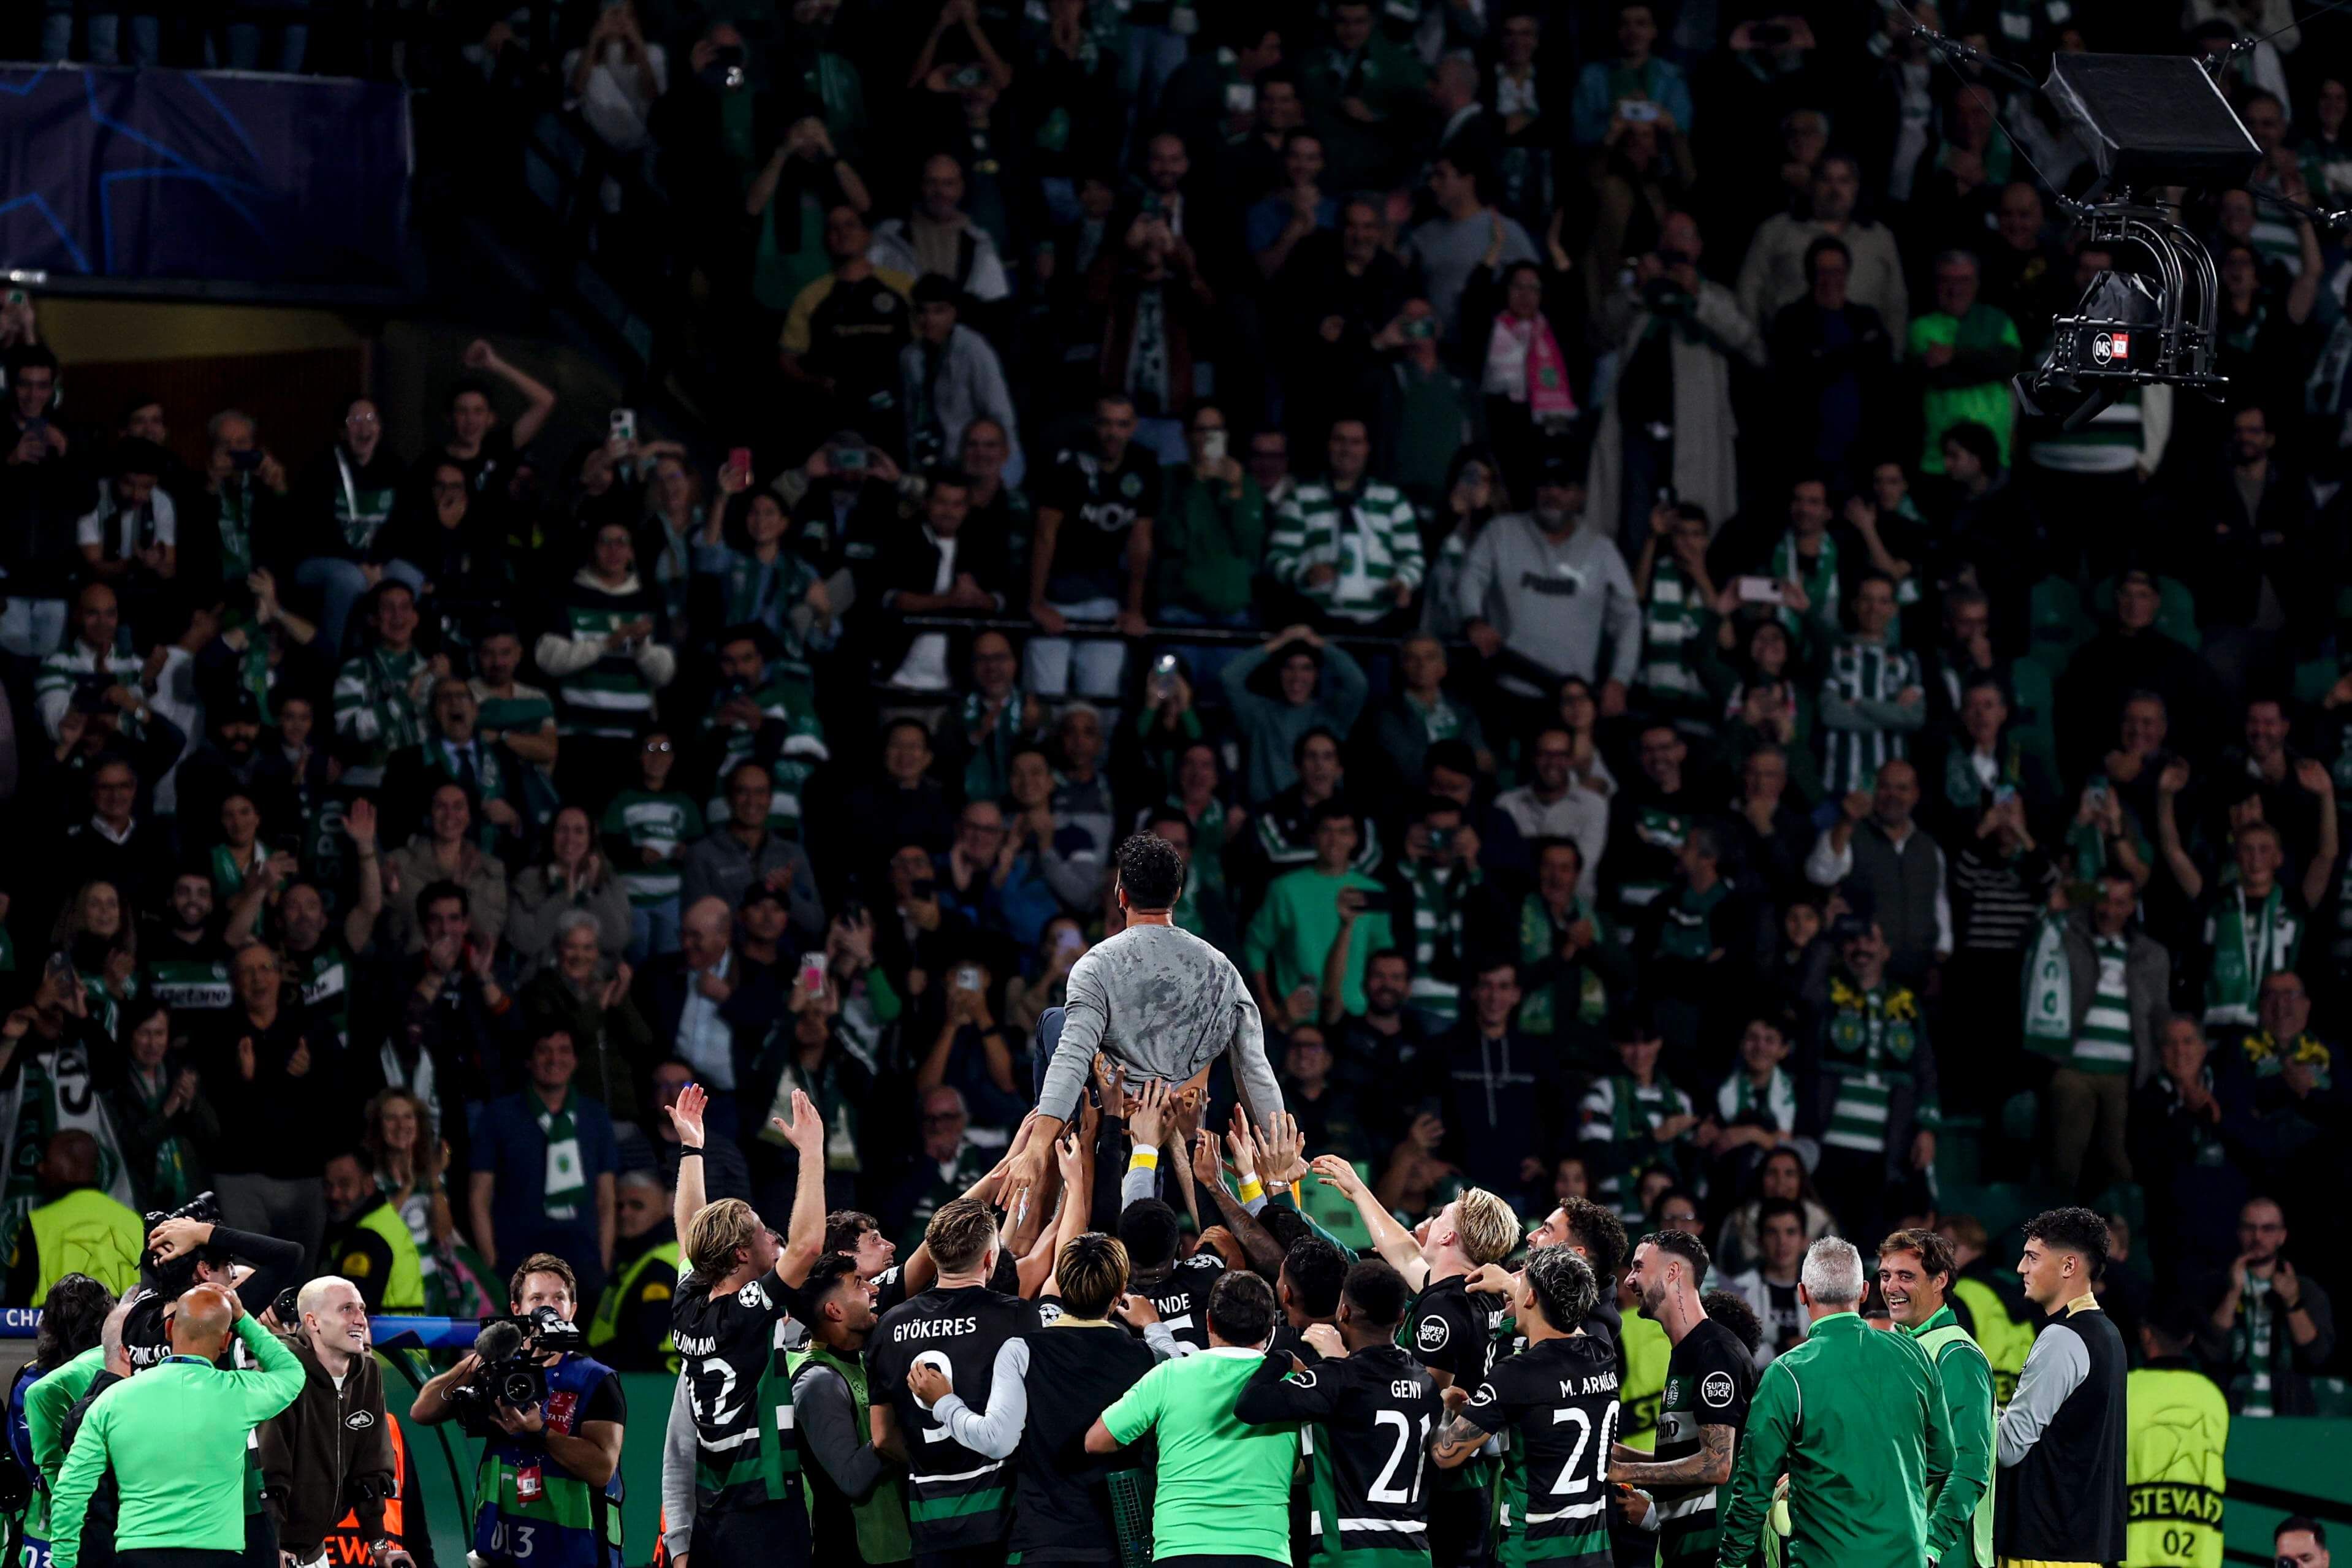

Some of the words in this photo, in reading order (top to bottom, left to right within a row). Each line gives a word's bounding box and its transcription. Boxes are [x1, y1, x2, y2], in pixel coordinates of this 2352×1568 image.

[894, 1317, 976, 1343] GYÖKERES
[1420, 1325, 1445, 1336] SUPER
[1420, 1332, 1442, 1344] BOCK
[1390, 1379, 1421, 1399] GENY
[1559, 1379, 1577, 1399] M.
[1706, 1382, 1730, 1391] SUPER
[1708, 1389, 1729, 1398] BOCK
[1549, 1399, 1620, 1494] 20
[1367, 1410, 1431, 1504] 21
[491, 1521, 536, 1558] 013
[2164, 1529, 2195, 1558] 02
